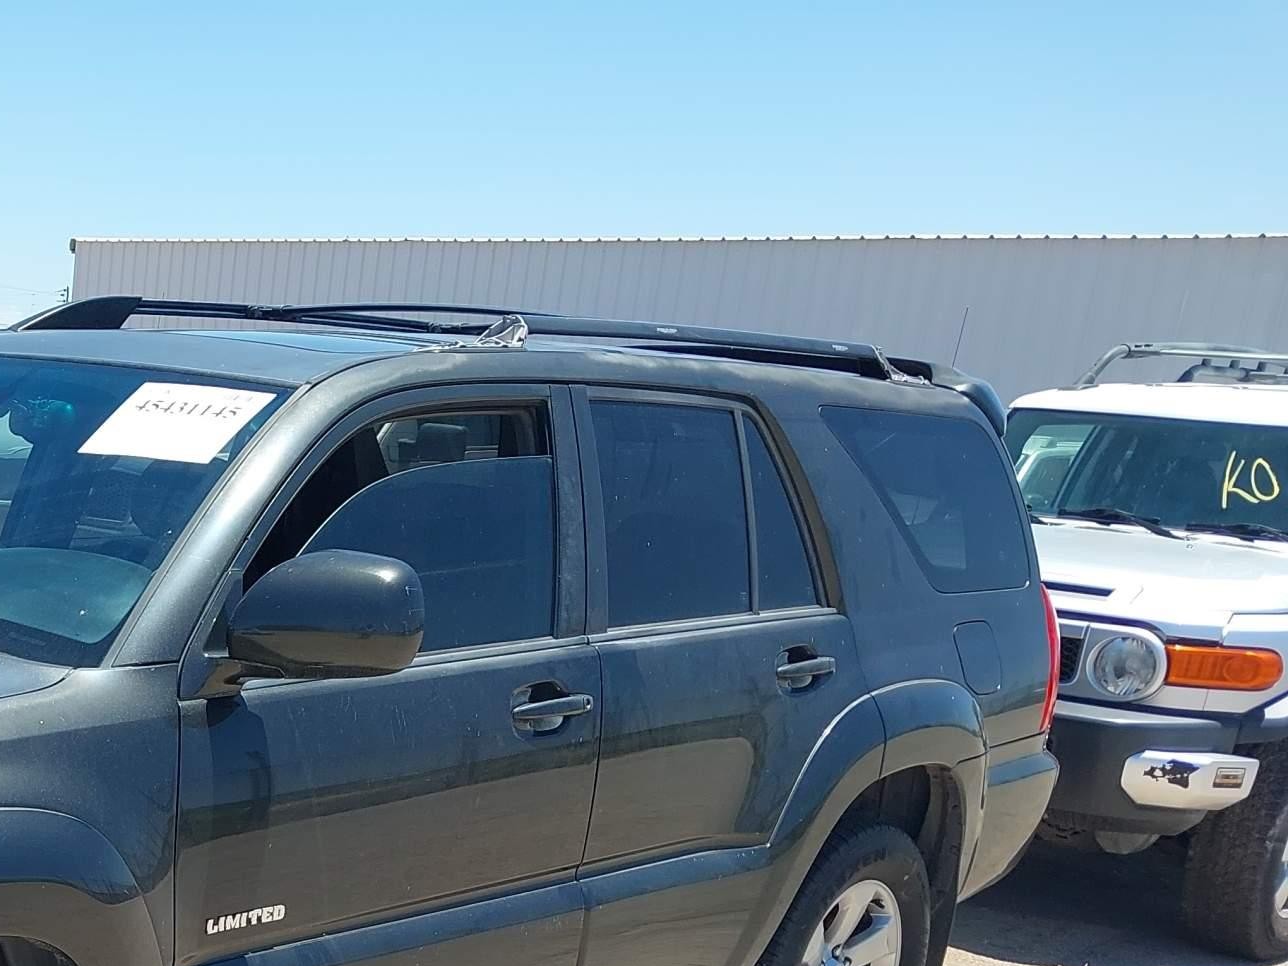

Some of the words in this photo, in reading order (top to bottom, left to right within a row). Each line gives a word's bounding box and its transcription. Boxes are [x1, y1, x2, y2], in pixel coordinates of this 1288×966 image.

[135, 398, 244, 419] 45431145
[1220, 450, 1281, 510] KO
[206, 904, 286, 935] LIMITED
